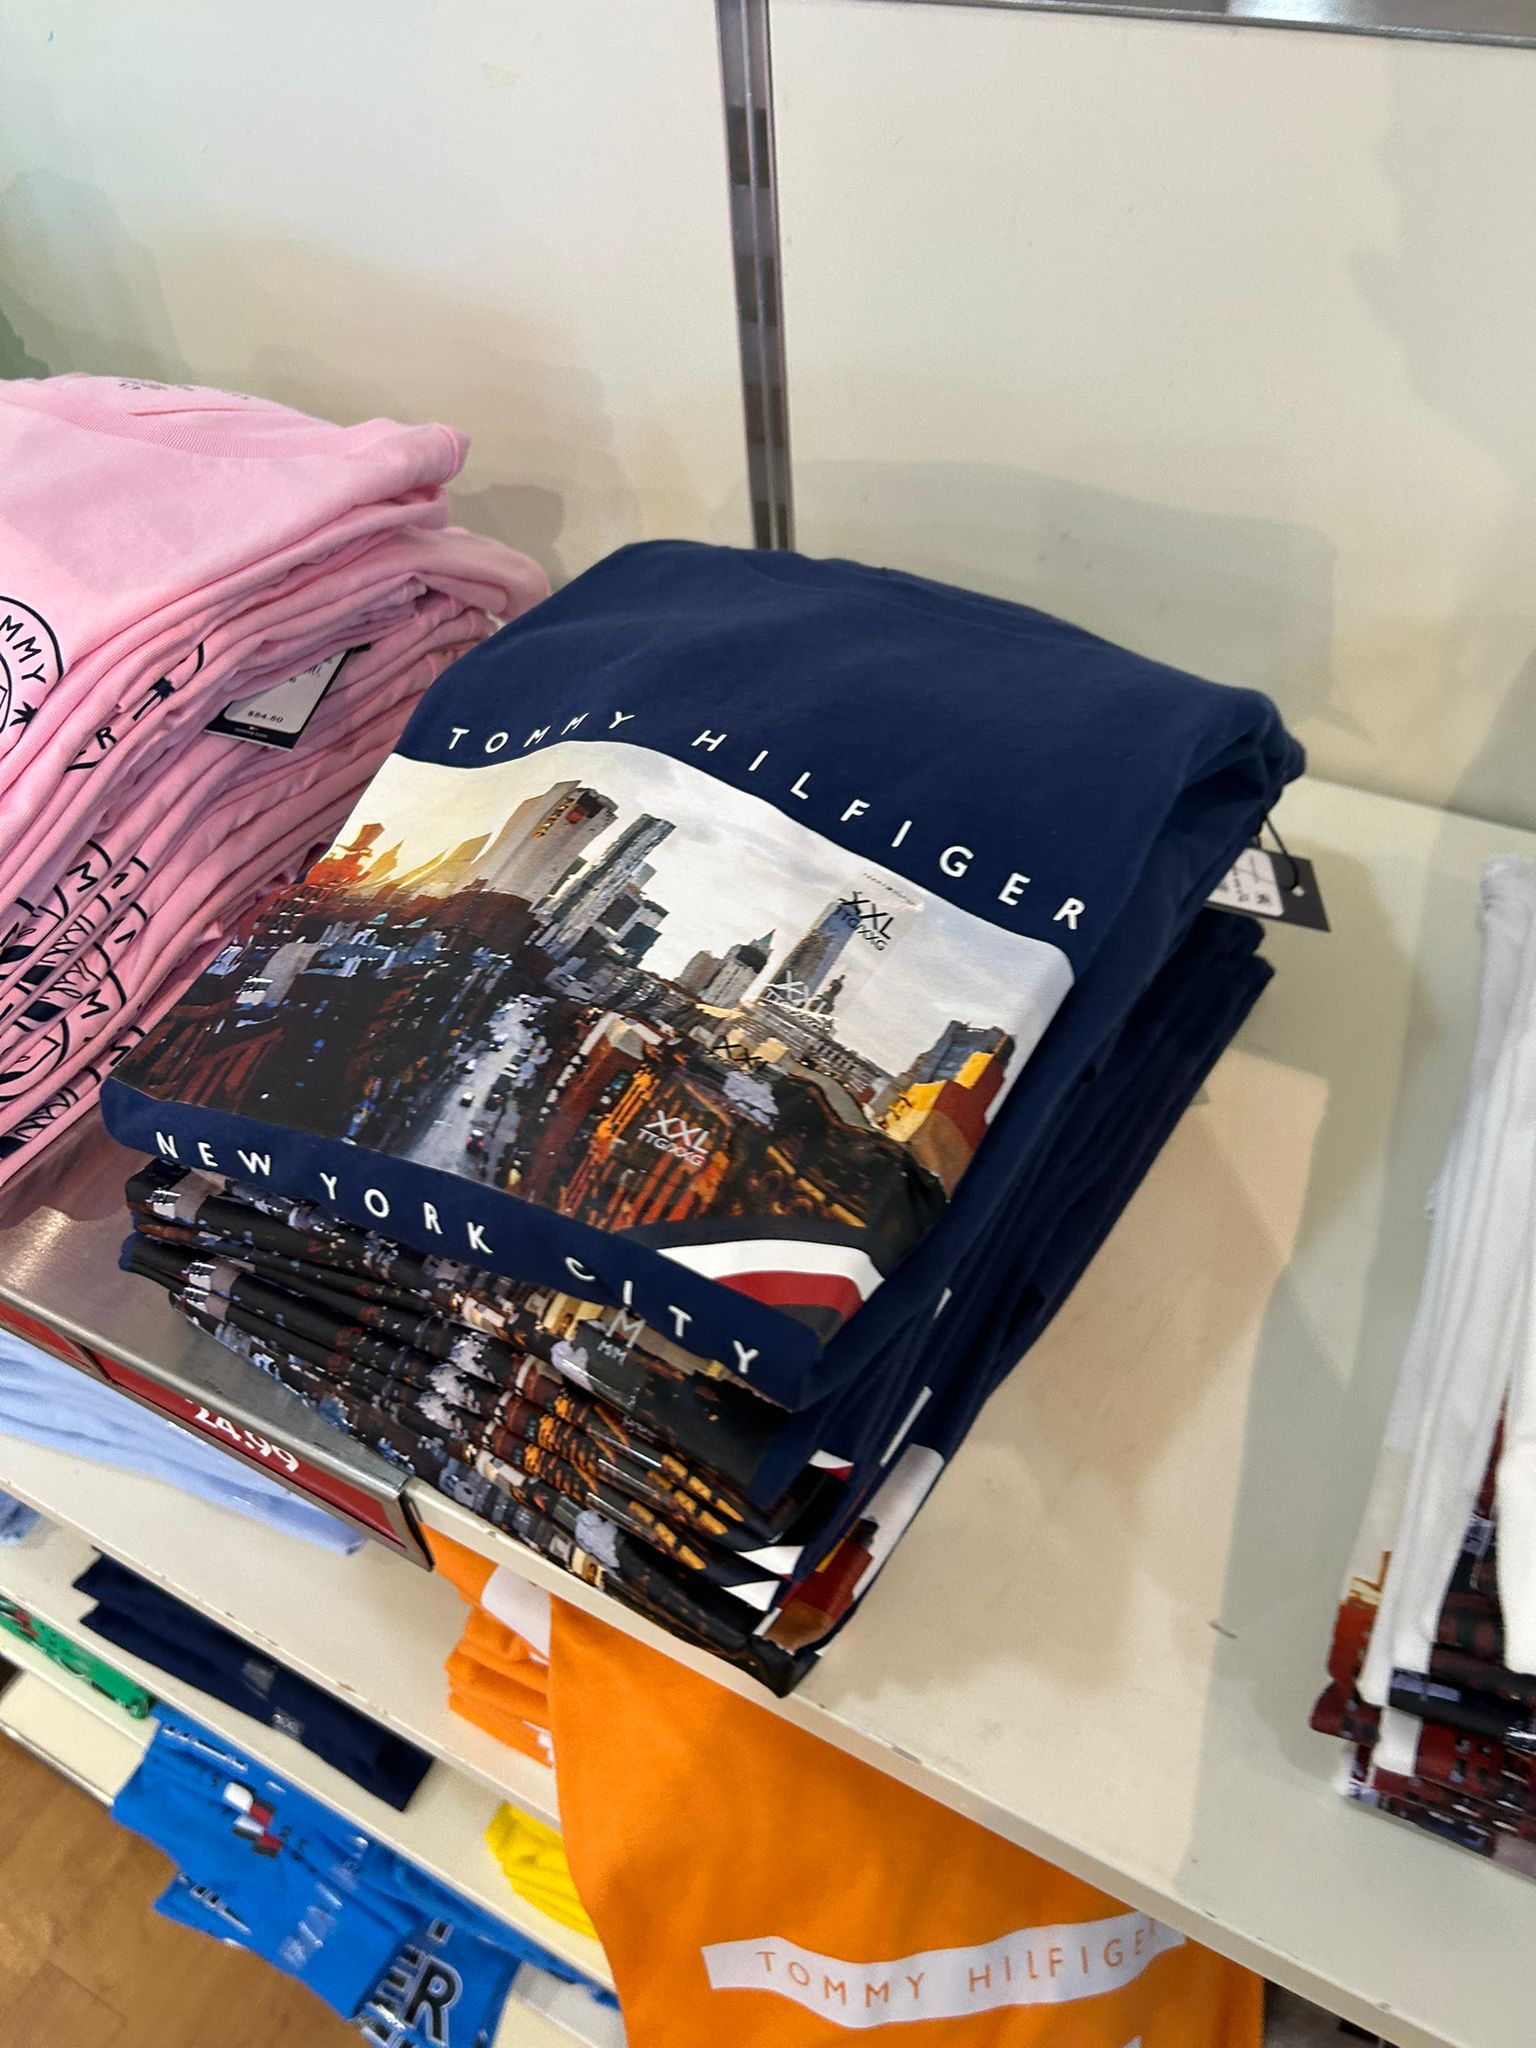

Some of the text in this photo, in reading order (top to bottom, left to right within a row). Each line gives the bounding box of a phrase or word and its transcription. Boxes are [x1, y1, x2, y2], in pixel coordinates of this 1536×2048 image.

[448, 710, 1086, 931] TOMMY HILFIGER
[838, 891, 895, 940] XXL
[644, 1109, 710, 1154] XXL
[155, 1130, 760, 1375] NEW YORK CITY
[604, 1308, 647, 1350] M
[755, 1949, 926, 2009] TOMMY
